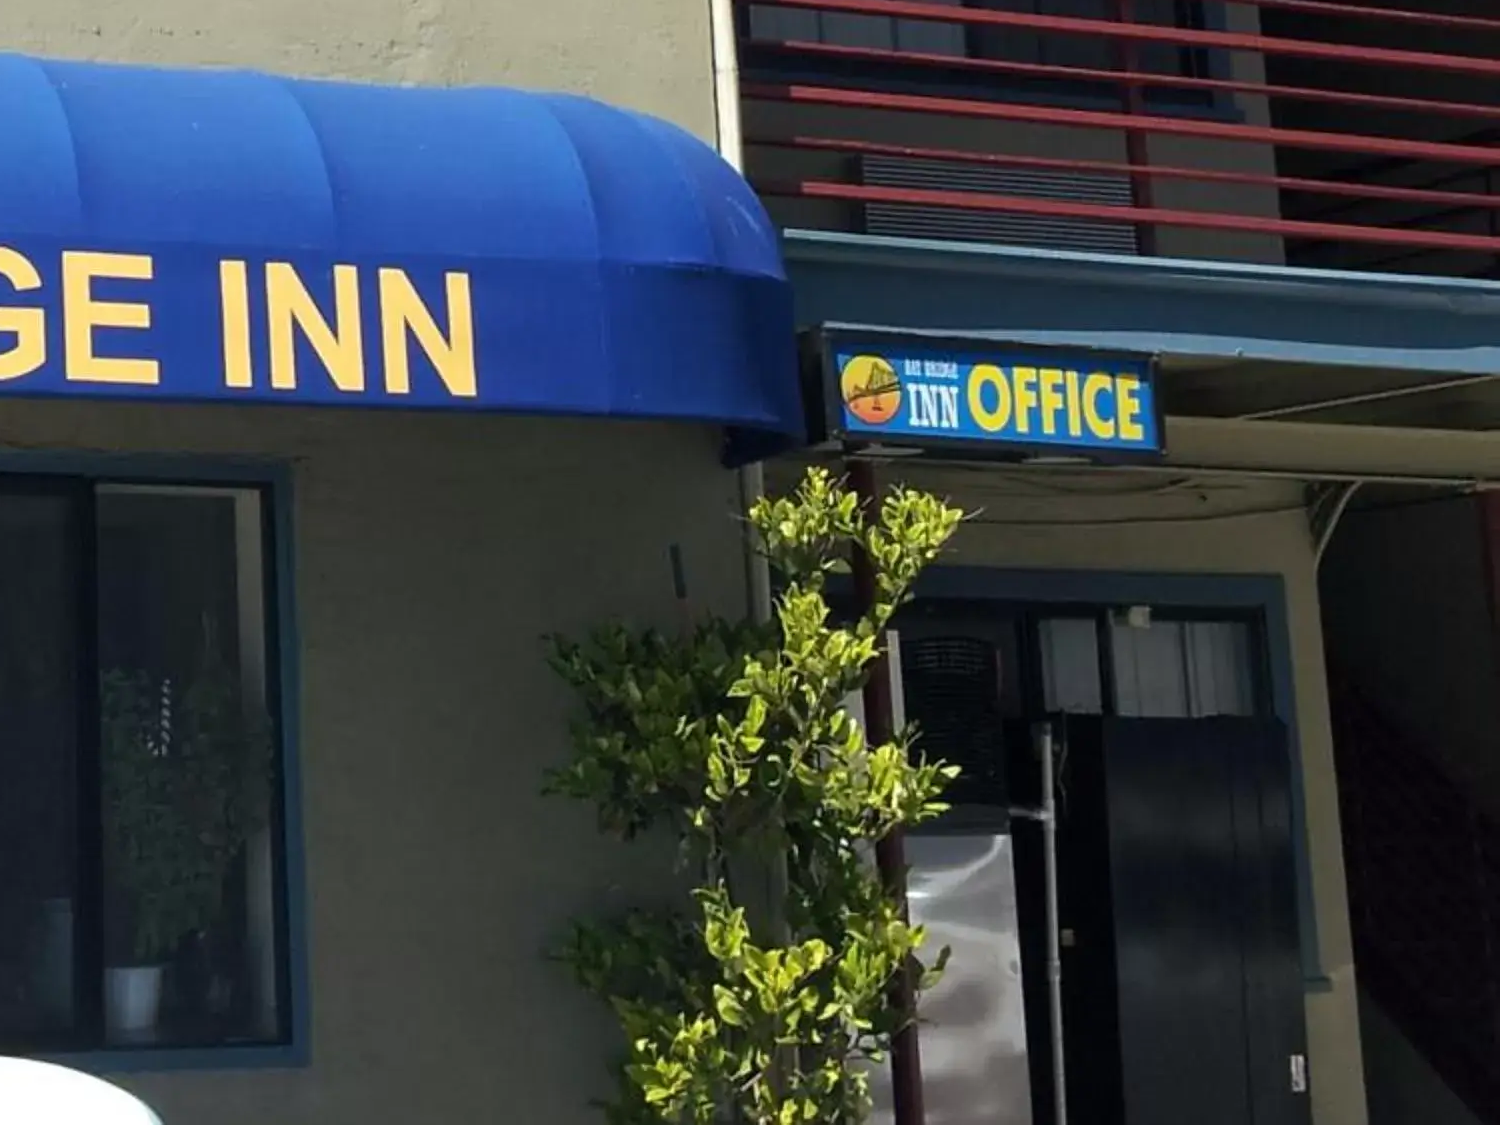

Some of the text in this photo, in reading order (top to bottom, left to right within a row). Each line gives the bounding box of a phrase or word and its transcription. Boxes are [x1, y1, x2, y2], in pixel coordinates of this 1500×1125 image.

[219, 259, 477, 397] INN
[907, 382, 959, 428] INN
[968, 364, 1144, 441] OFFICE
